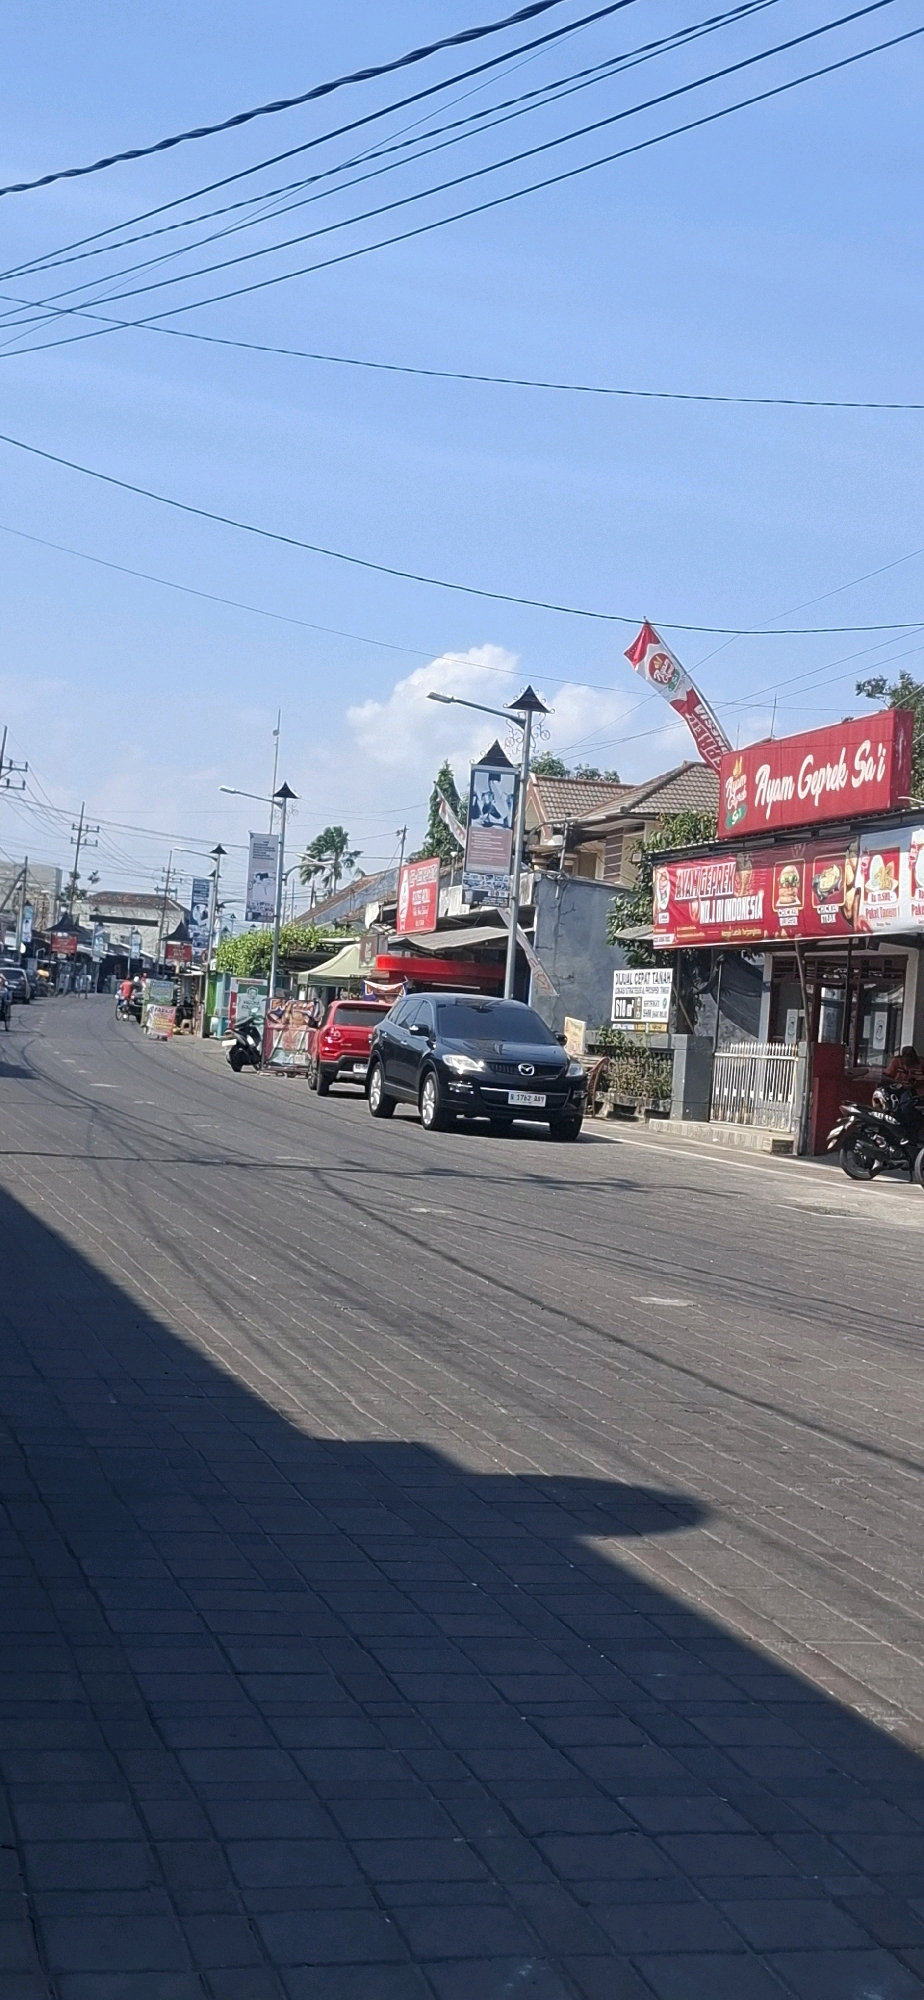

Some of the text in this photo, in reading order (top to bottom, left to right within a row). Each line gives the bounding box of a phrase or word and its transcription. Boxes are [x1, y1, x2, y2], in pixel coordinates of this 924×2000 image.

[754, 739, 887, 820] Ayam Geprek Sa'i
[699, 862, 736, 898] GEPREK
[724, 892, 764, 922] INDONESIA
[615, 971, 671, 985] DIJUAL CEPAT TANAH
